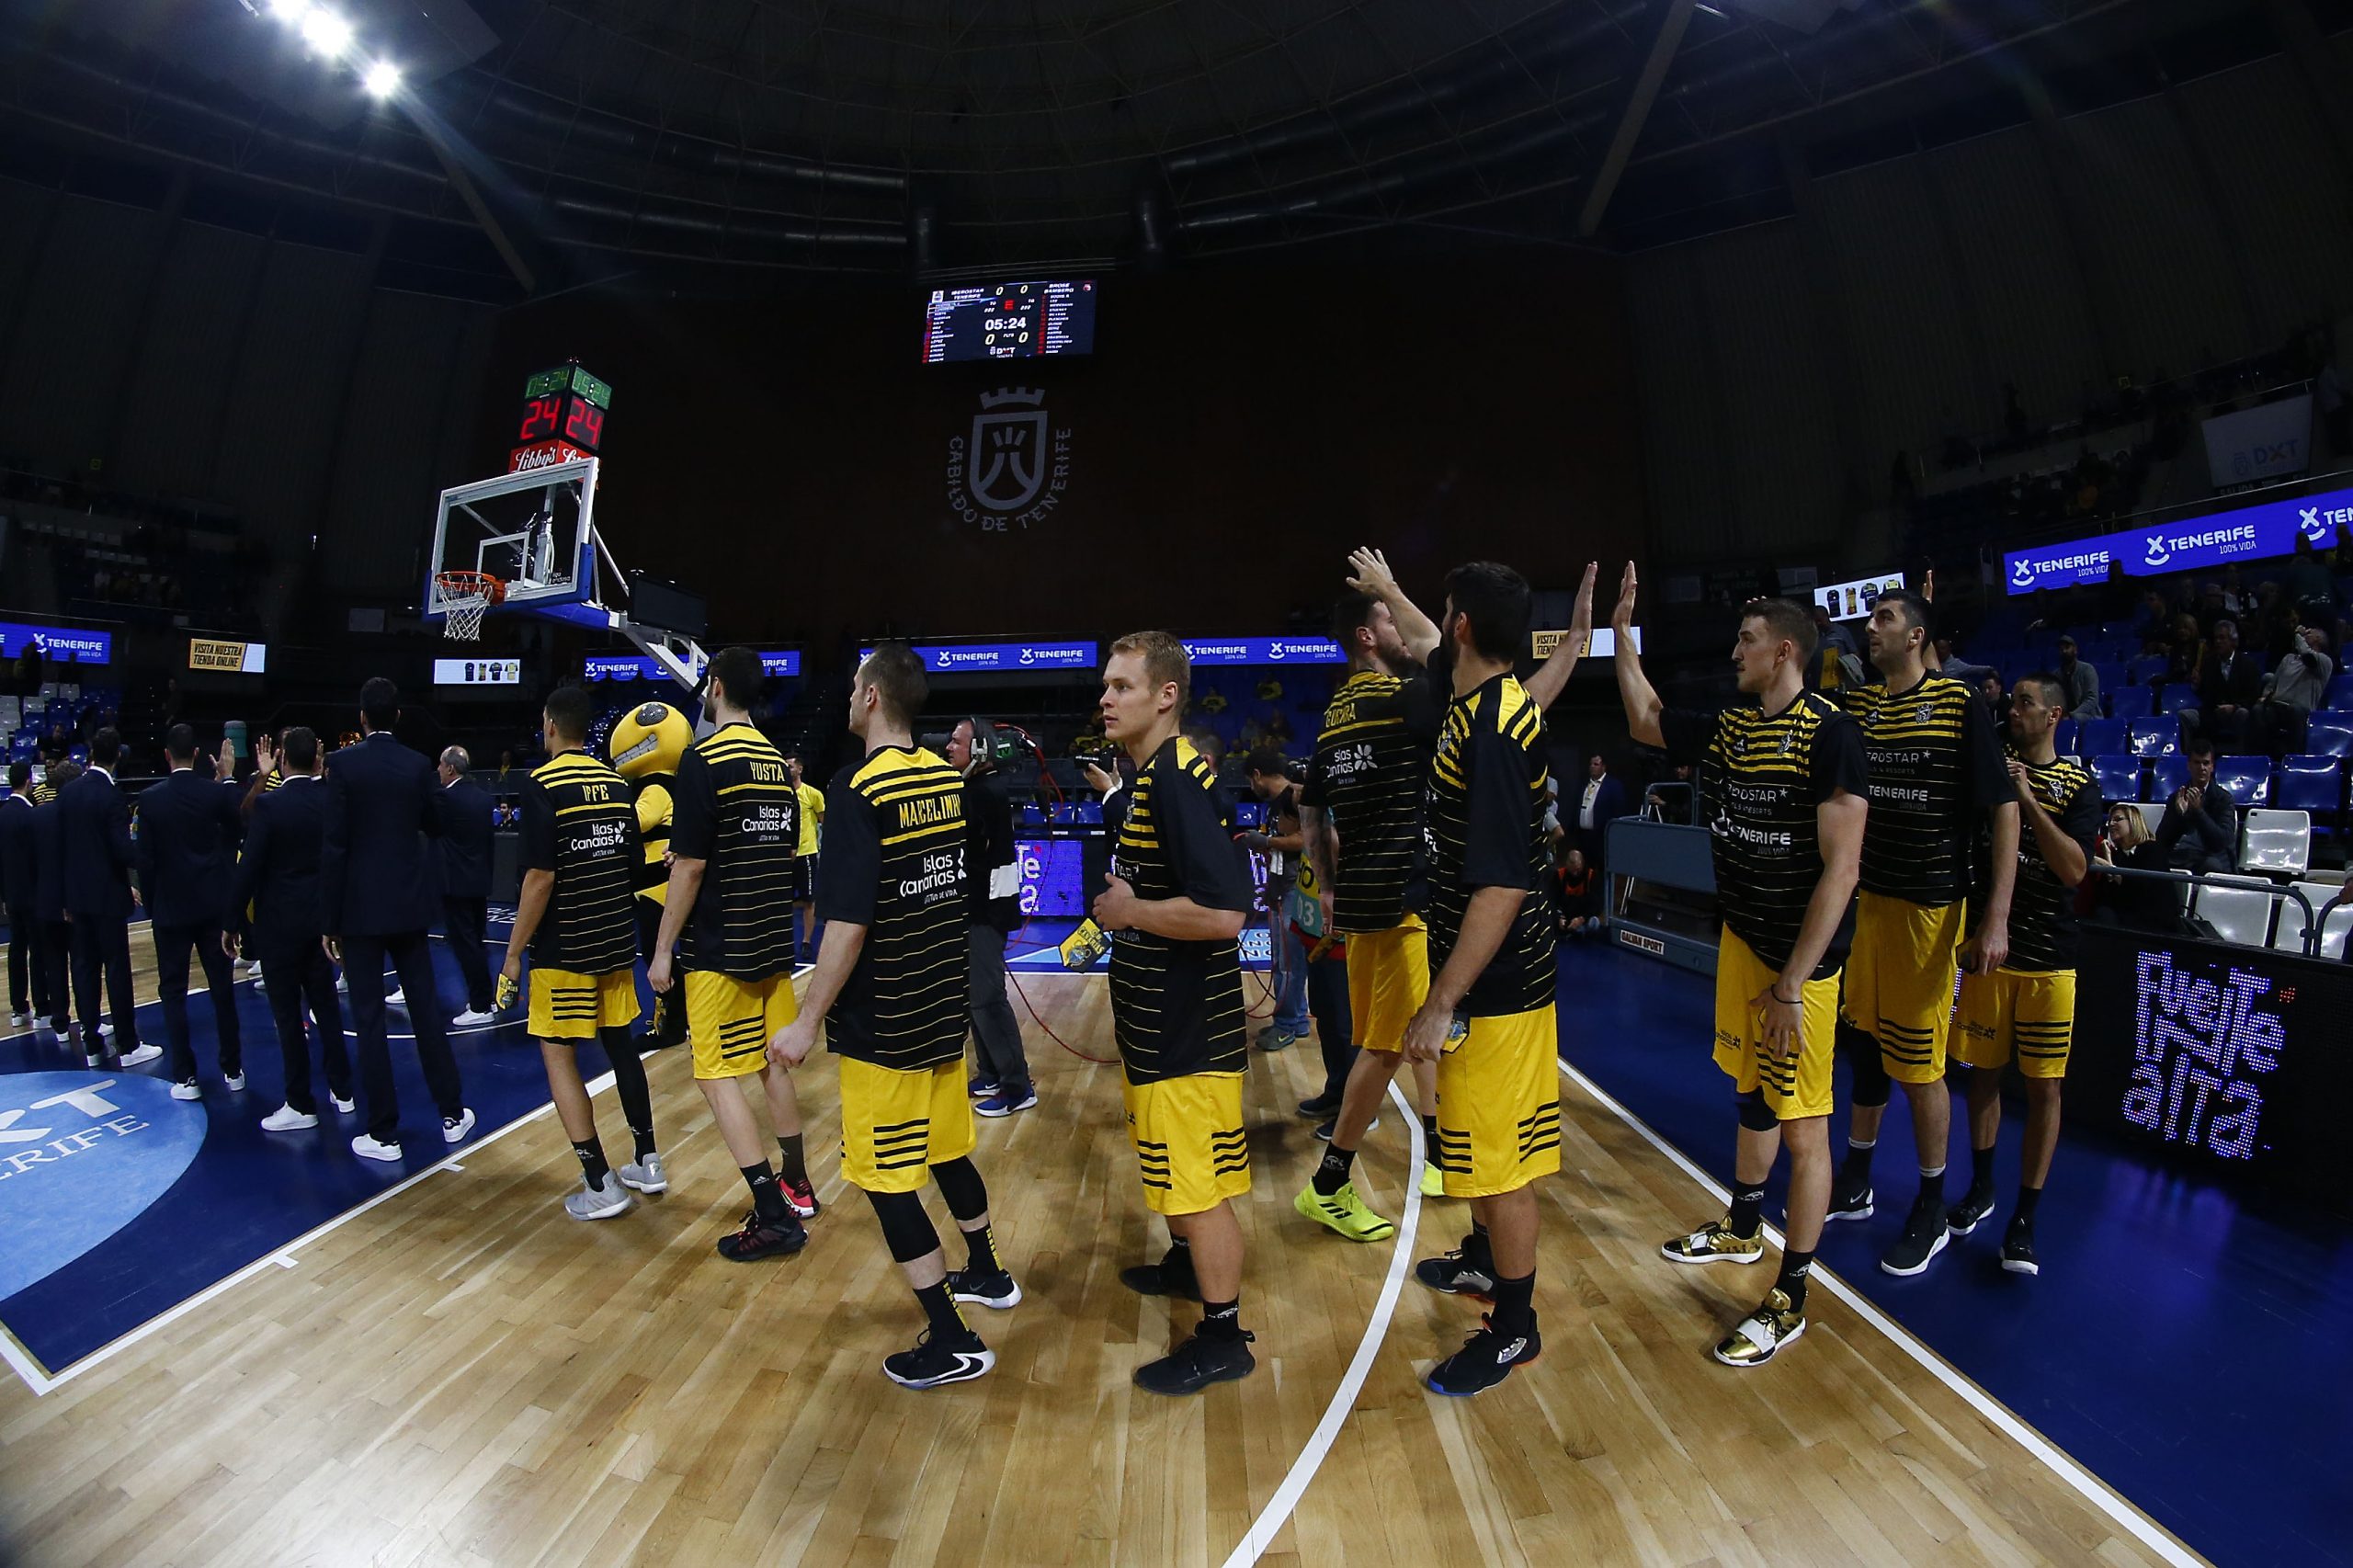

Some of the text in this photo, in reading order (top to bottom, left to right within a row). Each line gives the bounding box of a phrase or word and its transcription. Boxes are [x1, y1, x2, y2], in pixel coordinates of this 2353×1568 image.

[995, 286, 1004, 296] 0
[1020, 284, 1029, 294] 0
[984, 317, 1027, 331] 05:24
[984, 334, 995, 346] 0
[1017, 331, 1029, 344] 0
[519, 397, 563, 440] 24
[564, 399, 604, 446] 24
[515, 447, 556, 472] Libby's
[947, 427, 1072, 531] CABILDO DE TENERIFE
[2167, 524, 2256, 551] TENERIFE
[2219, 540, 2256, 555] 100% VIDA
[2033, 551, 2109, 574] TENERIFE
[2078, 568, 2095, 577] 100%
[47, 638, 103, 651] TENERIFE
[195, 643, 242, 655] VISITA NUESTRA
[1195, 646, 1247, 654] TENERIFE
[1284, 644, 1337, 653] TENERIFE
[194, 654, 239, 666] TIENDA ONLINE
[951, 652, 999, 661] TENERIFE
[1033, 649, 1084, 659] TENERIFE
[597, 664, 639, 672] TENERIFE
[762, 659, 788, 667] ERIFE
[1334, 748, 1352, 763] slas
[749, 761, 786, 782] YUSTA
[1869, 785, 1928, 801] TENERIFE
[759, 805, 779, 819] Islas
[742, 818, 780, 832] Canarias
[923, 854, 953, 874] Islas
